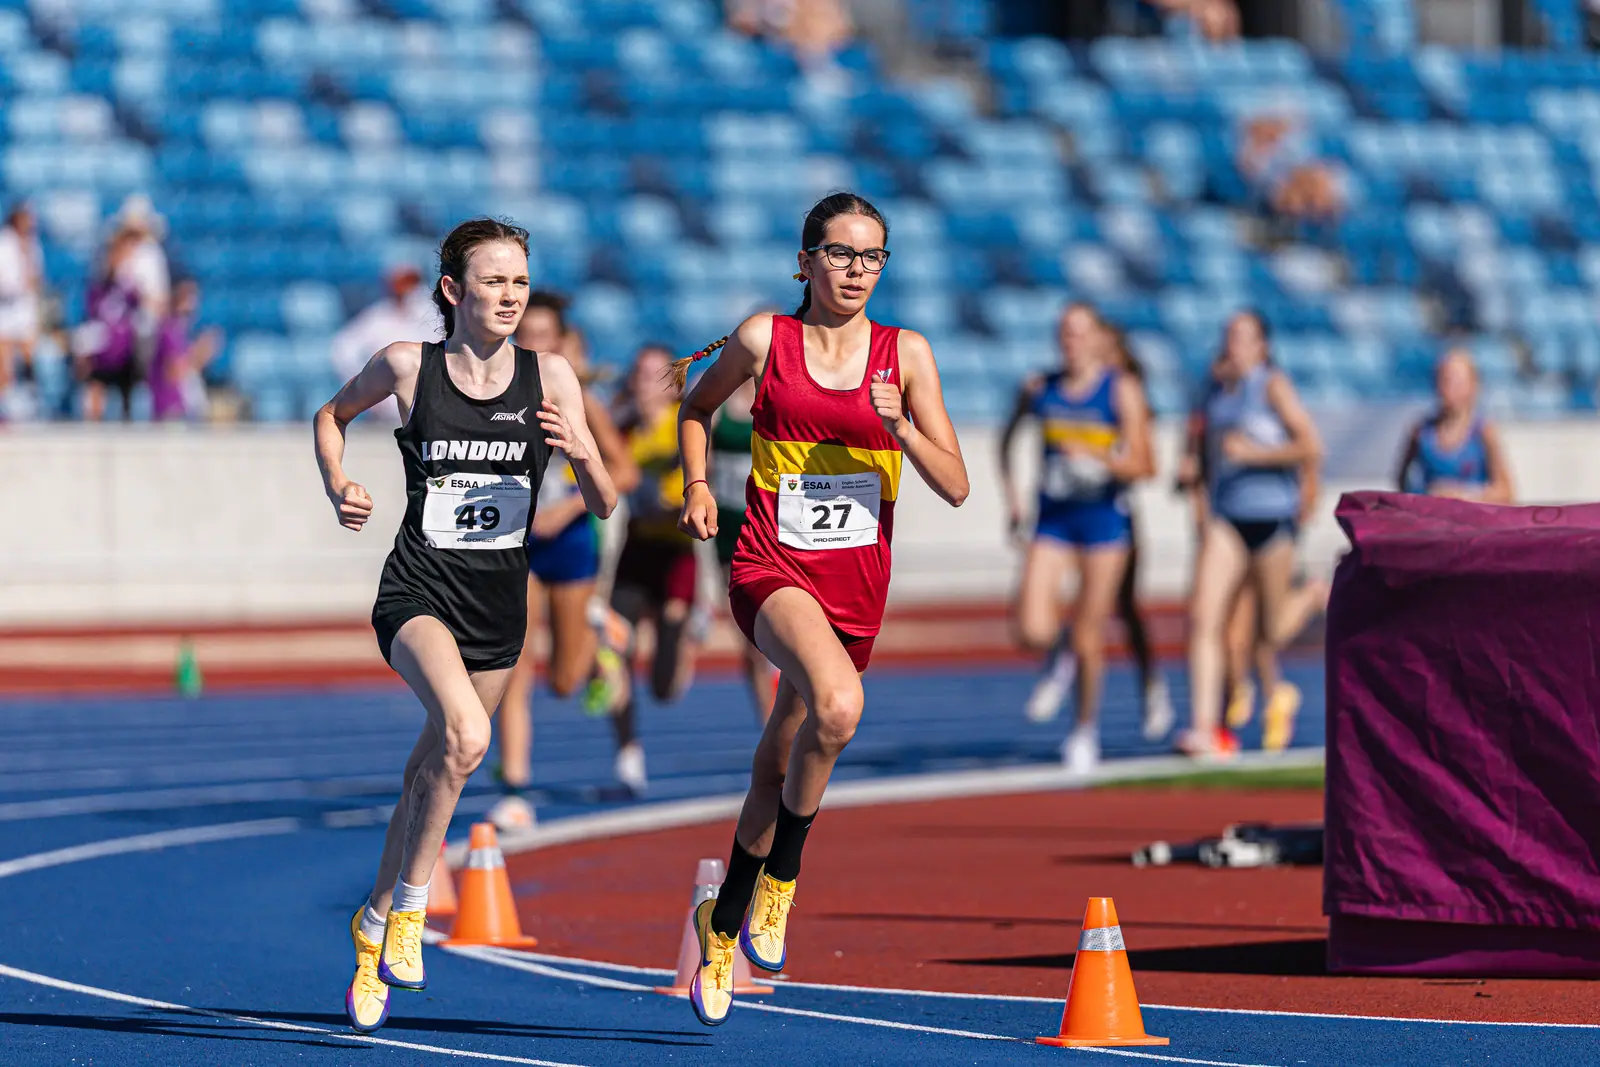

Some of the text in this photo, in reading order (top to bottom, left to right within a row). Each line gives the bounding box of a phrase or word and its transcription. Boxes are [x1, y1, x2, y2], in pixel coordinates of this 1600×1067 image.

[421, 440, 528, 461] LONDON
[450, 479, 480, 489] ESAA
[803, 481, 832, 490] ESAA
[455, 504, 501, 530] 49
[811, 503, 852, 530] 27
